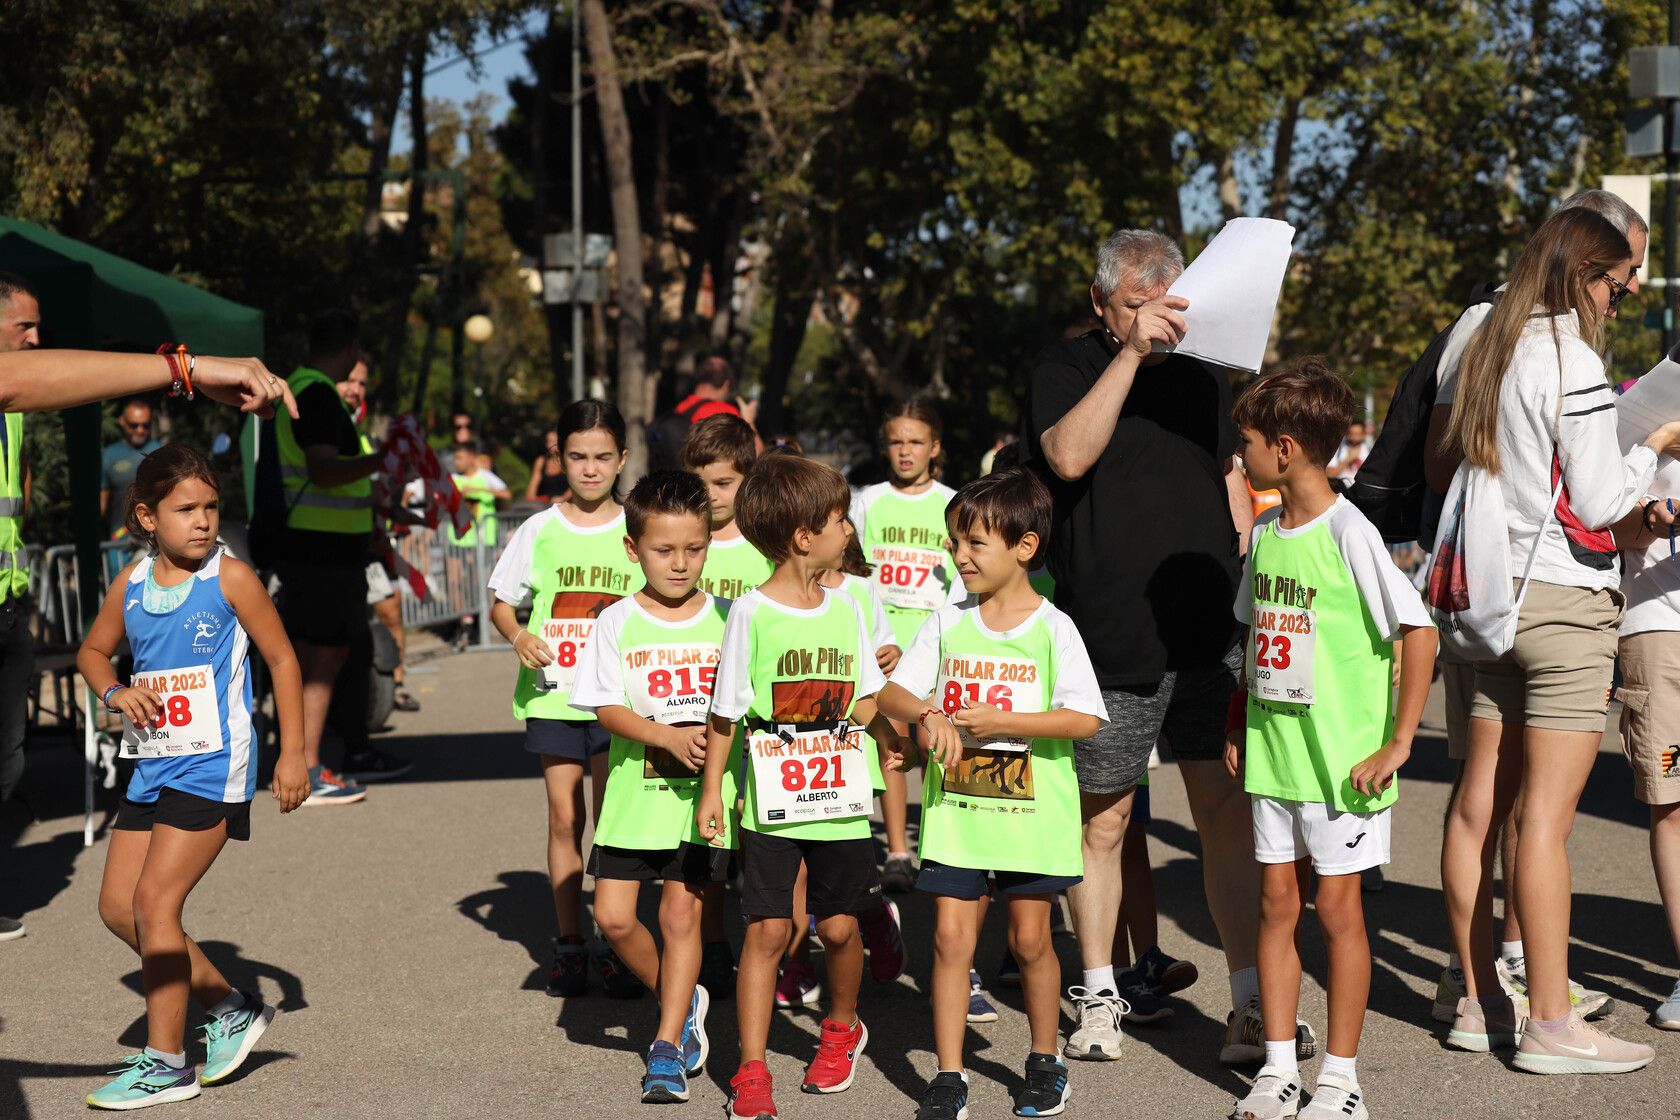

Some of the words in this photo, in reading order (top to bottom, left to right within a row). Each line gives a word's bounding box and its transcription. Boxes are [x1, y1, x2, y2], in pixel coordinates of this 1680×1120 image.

[881, 526, 905, 543] 10k
[889, 549, 917, 565] PILAR
[920, 553, 943, 568] 2023
[555, 566, 585, 587] 10k
[880, 563, 930, 588] 807
[1255, 572, 1272, 601] 0k
[696, 577, 714, 596] 0k
[719, 578, 758, 600] Pil
[183, 611, 221, 630] ATLETISMO
[544, 624, 564, 638] 10K
[1279, 613, 1311, 635] 2023
[557, 640, 586, 668] 8
[625, 650, 653, 669] 10K
[657, 648, 702, 666] PILAR
[1256, 632, 1292, 670] 23
[777, 649, 813, 676] 10k
[953, 659, 995, 680] PILAR
[999, 663, 1037, 683] 2023
[171, 672, 207, 692] 2023
[647, 667, 716, 698] 815
[666, 697, 706, 707] ÁLVARO
[755, 739, 785, 757] 10K
[788, 735, 832, 756] PILAR
[832, 732, 860, 752] 2023
[780, 754, 846, 792] 821
[796, 791, 839, 803] ALBERTO
